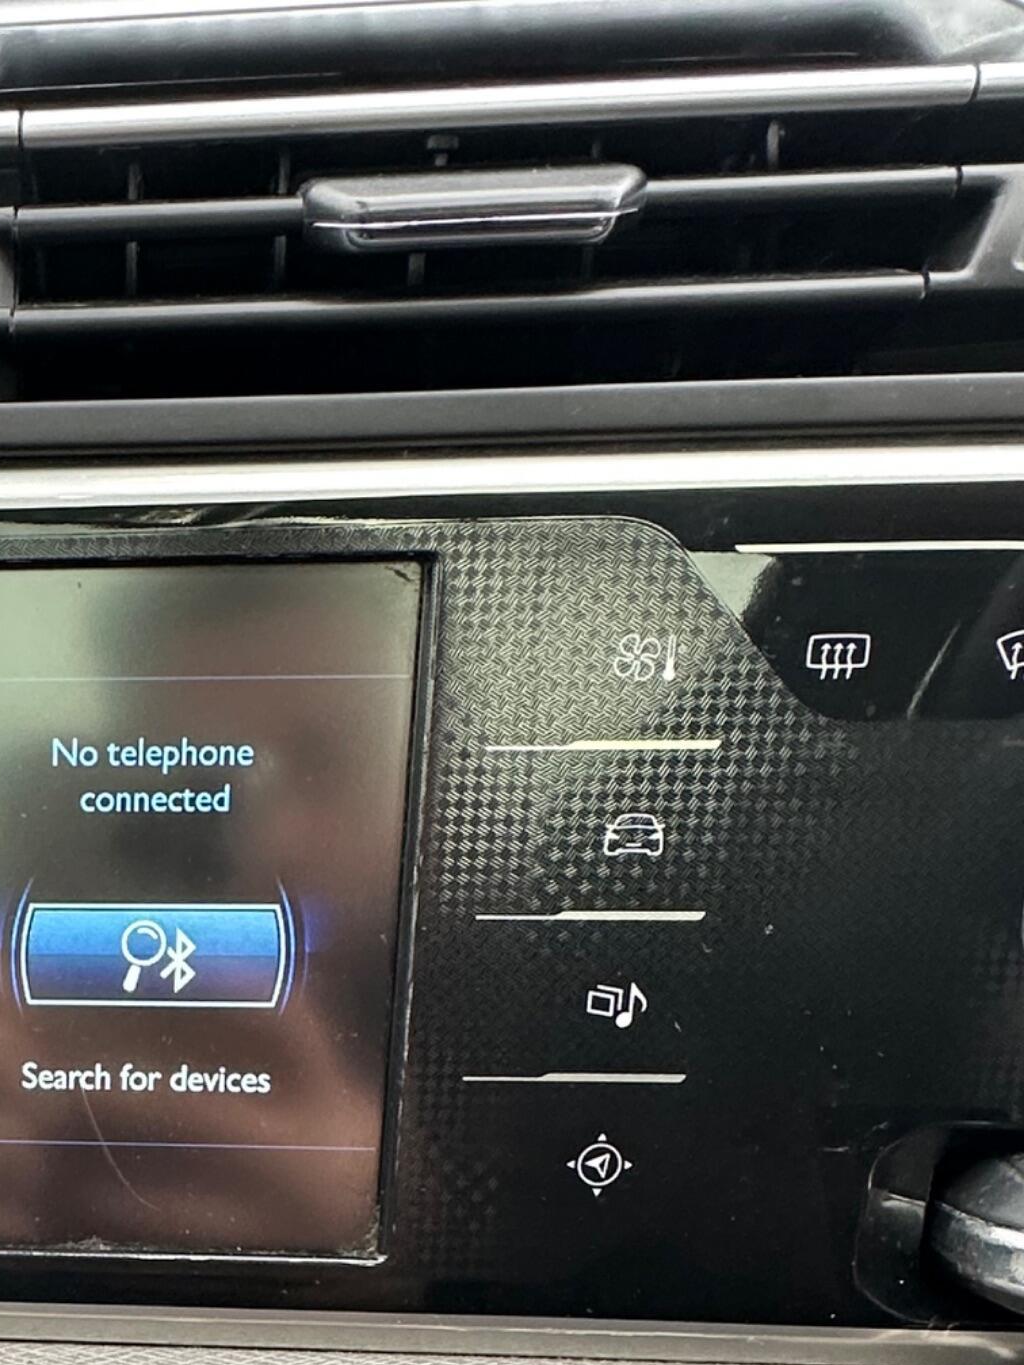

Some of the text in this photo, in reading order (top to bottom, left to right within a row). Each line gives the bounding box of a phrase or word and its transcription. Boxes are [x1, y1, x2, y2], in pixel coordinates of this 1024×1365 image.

[51, 737, 255, 775] No telephone
[79, 784, 231, 813] connected
[21, 1061, 271, 1094] Search for devices
